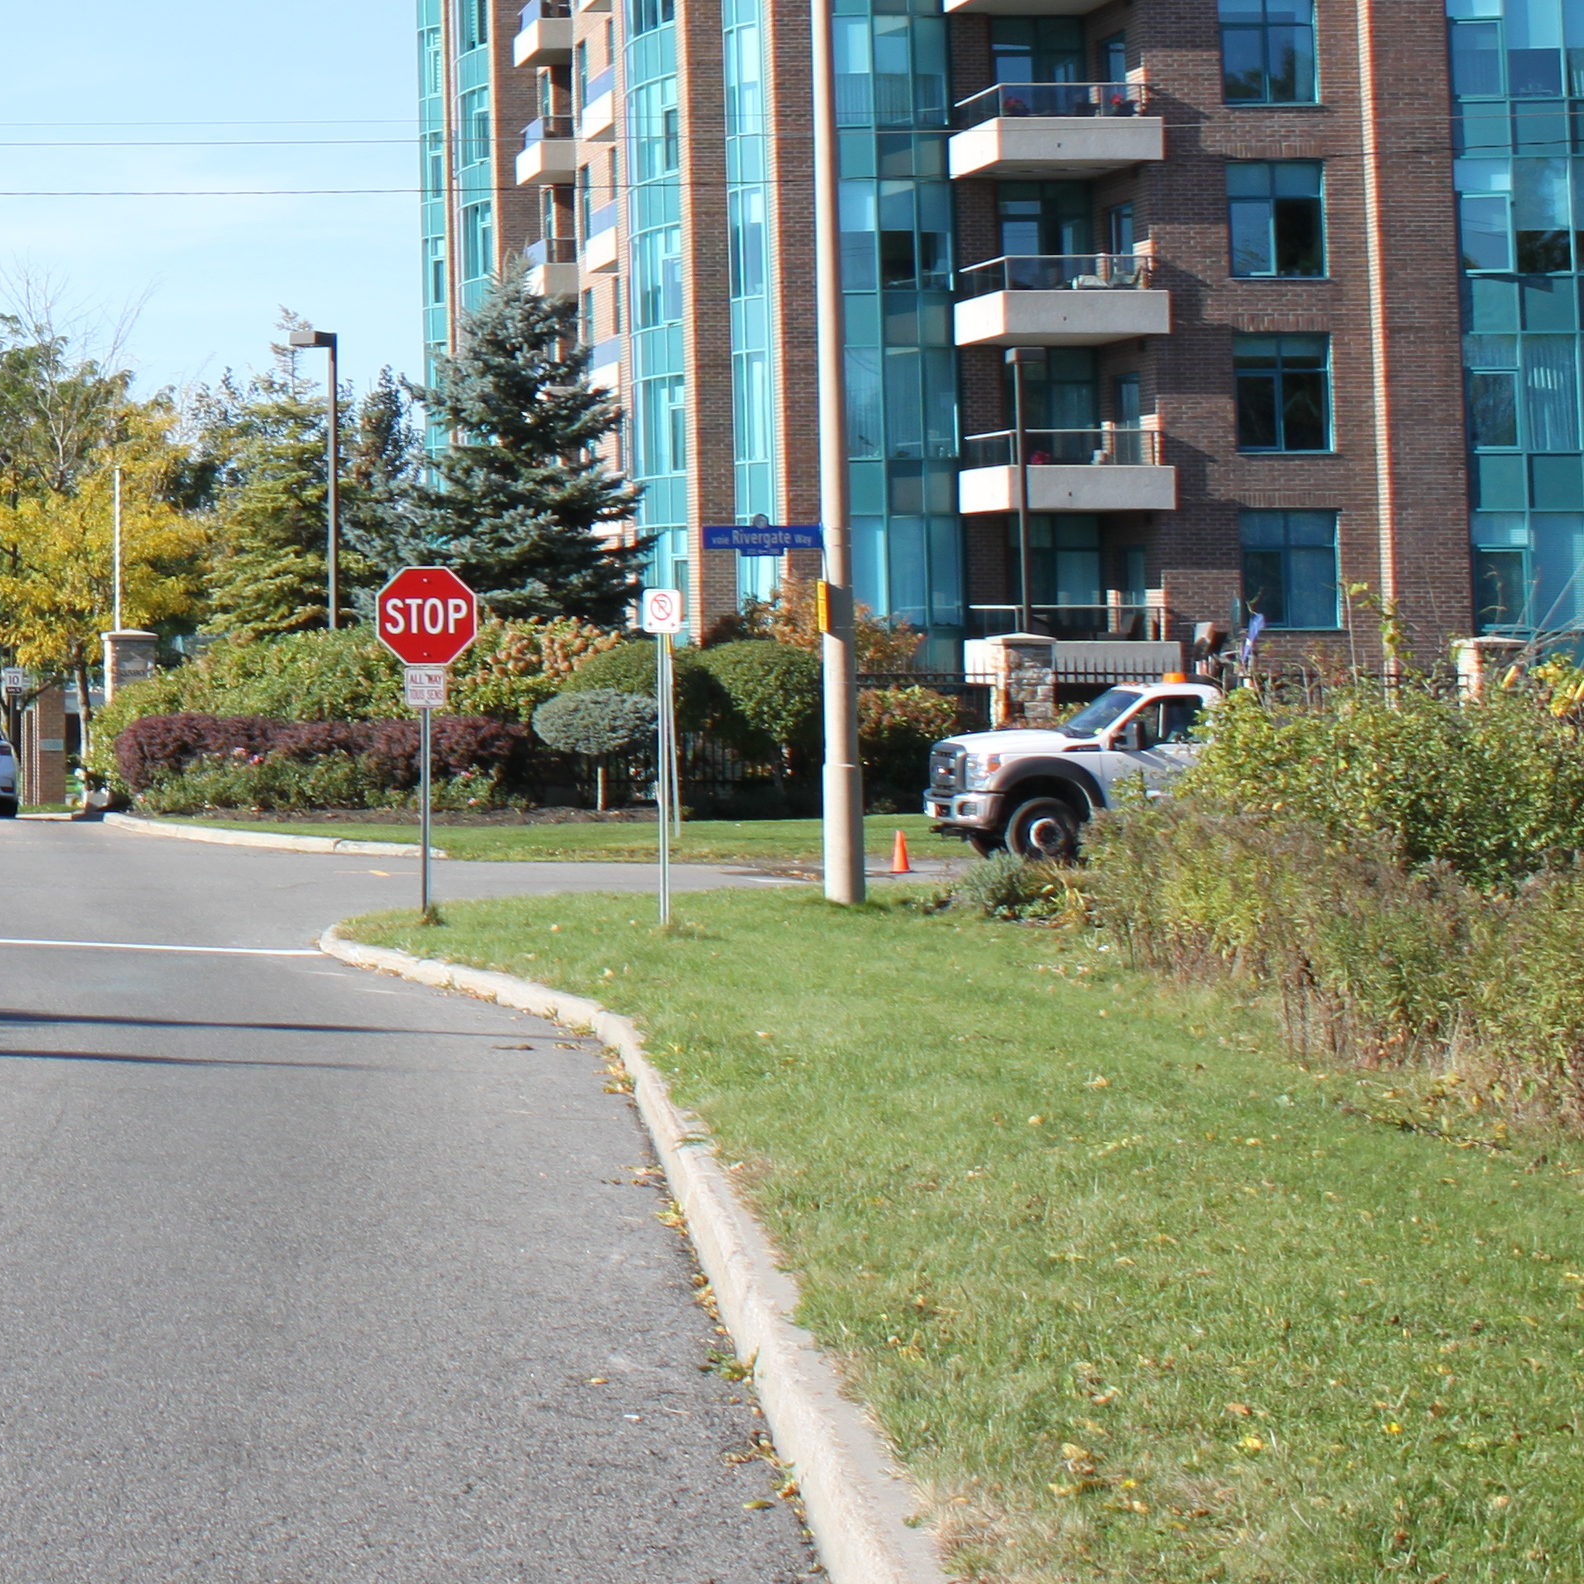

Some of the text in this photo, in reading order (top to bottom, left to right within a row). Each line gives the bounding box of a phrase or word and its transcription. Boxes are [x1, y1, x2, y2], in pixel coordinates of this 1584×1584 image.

[732, 529, 791, 548] Rivergate
[793, 533, 812, 547] Way
[384, 597, 468, 635] STOP
